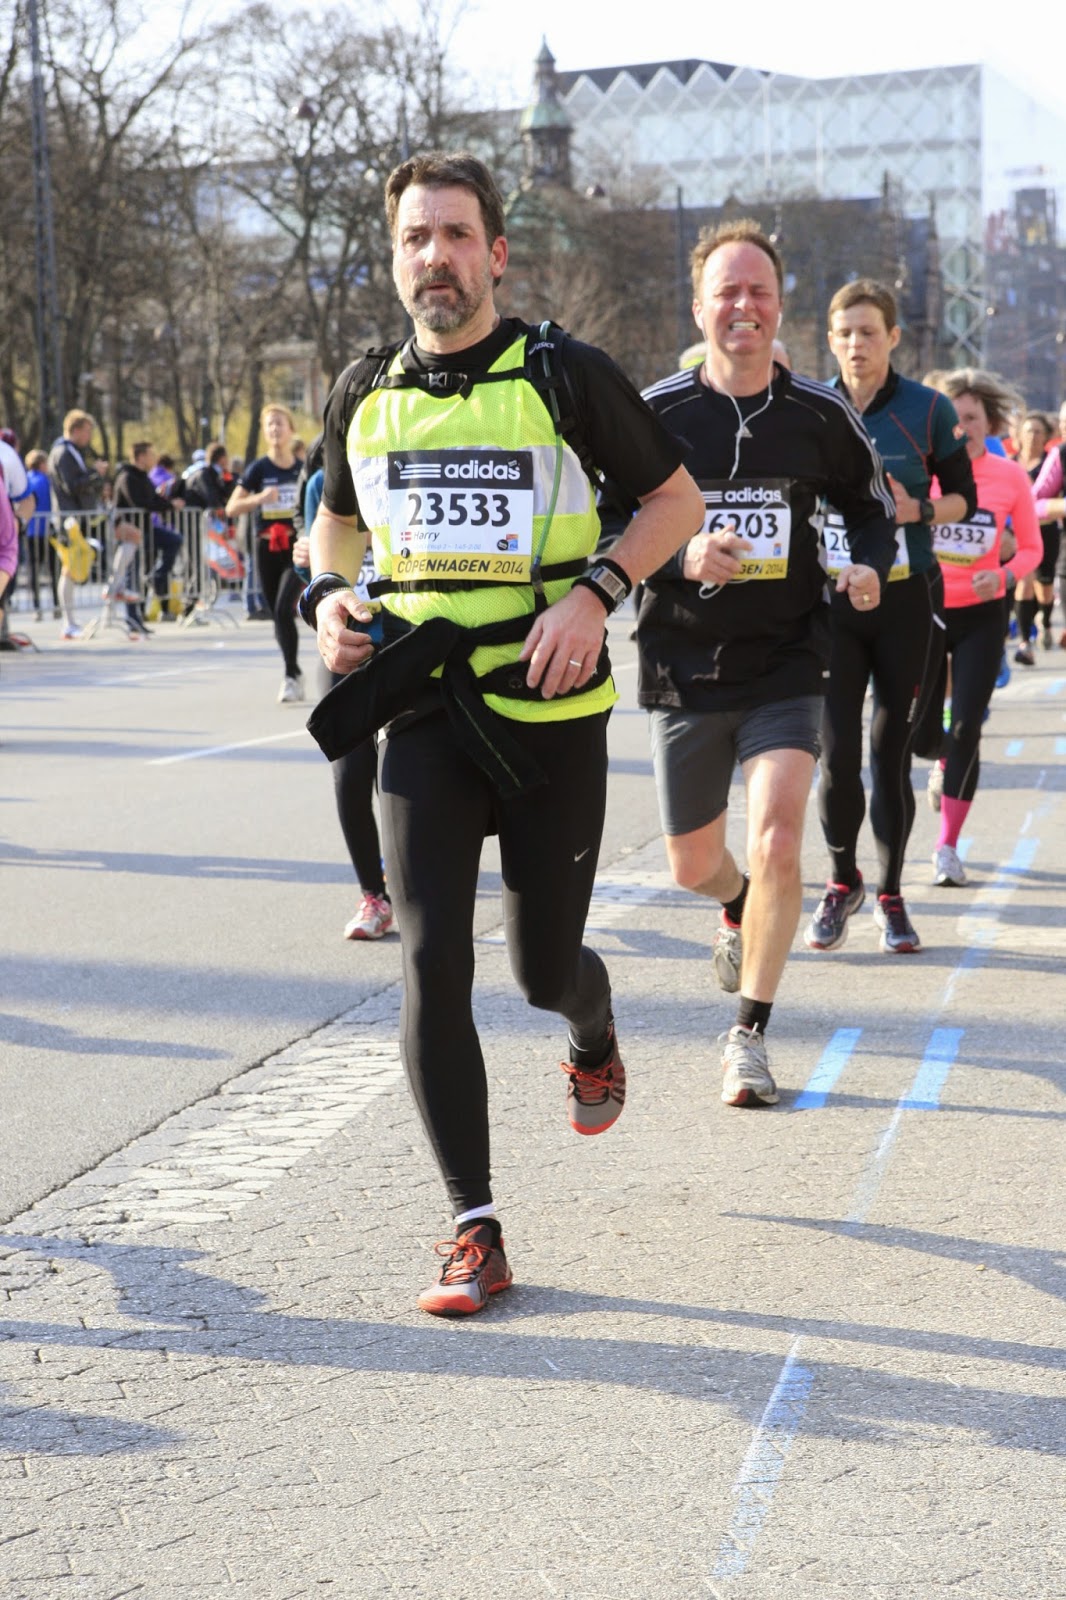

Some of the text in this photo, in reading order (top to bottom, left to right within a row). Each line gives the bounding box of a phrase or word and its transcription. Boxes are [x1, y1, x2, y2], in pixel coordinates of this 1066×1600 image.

[444, 460, 521, 480] adidas
[724, 487, 782, 502] adidas
[408, 492, 511, 527] 23533
[414, 531, 440, 542] Harry
[397, 559, 523, 575] COPENHAGEN 2014
